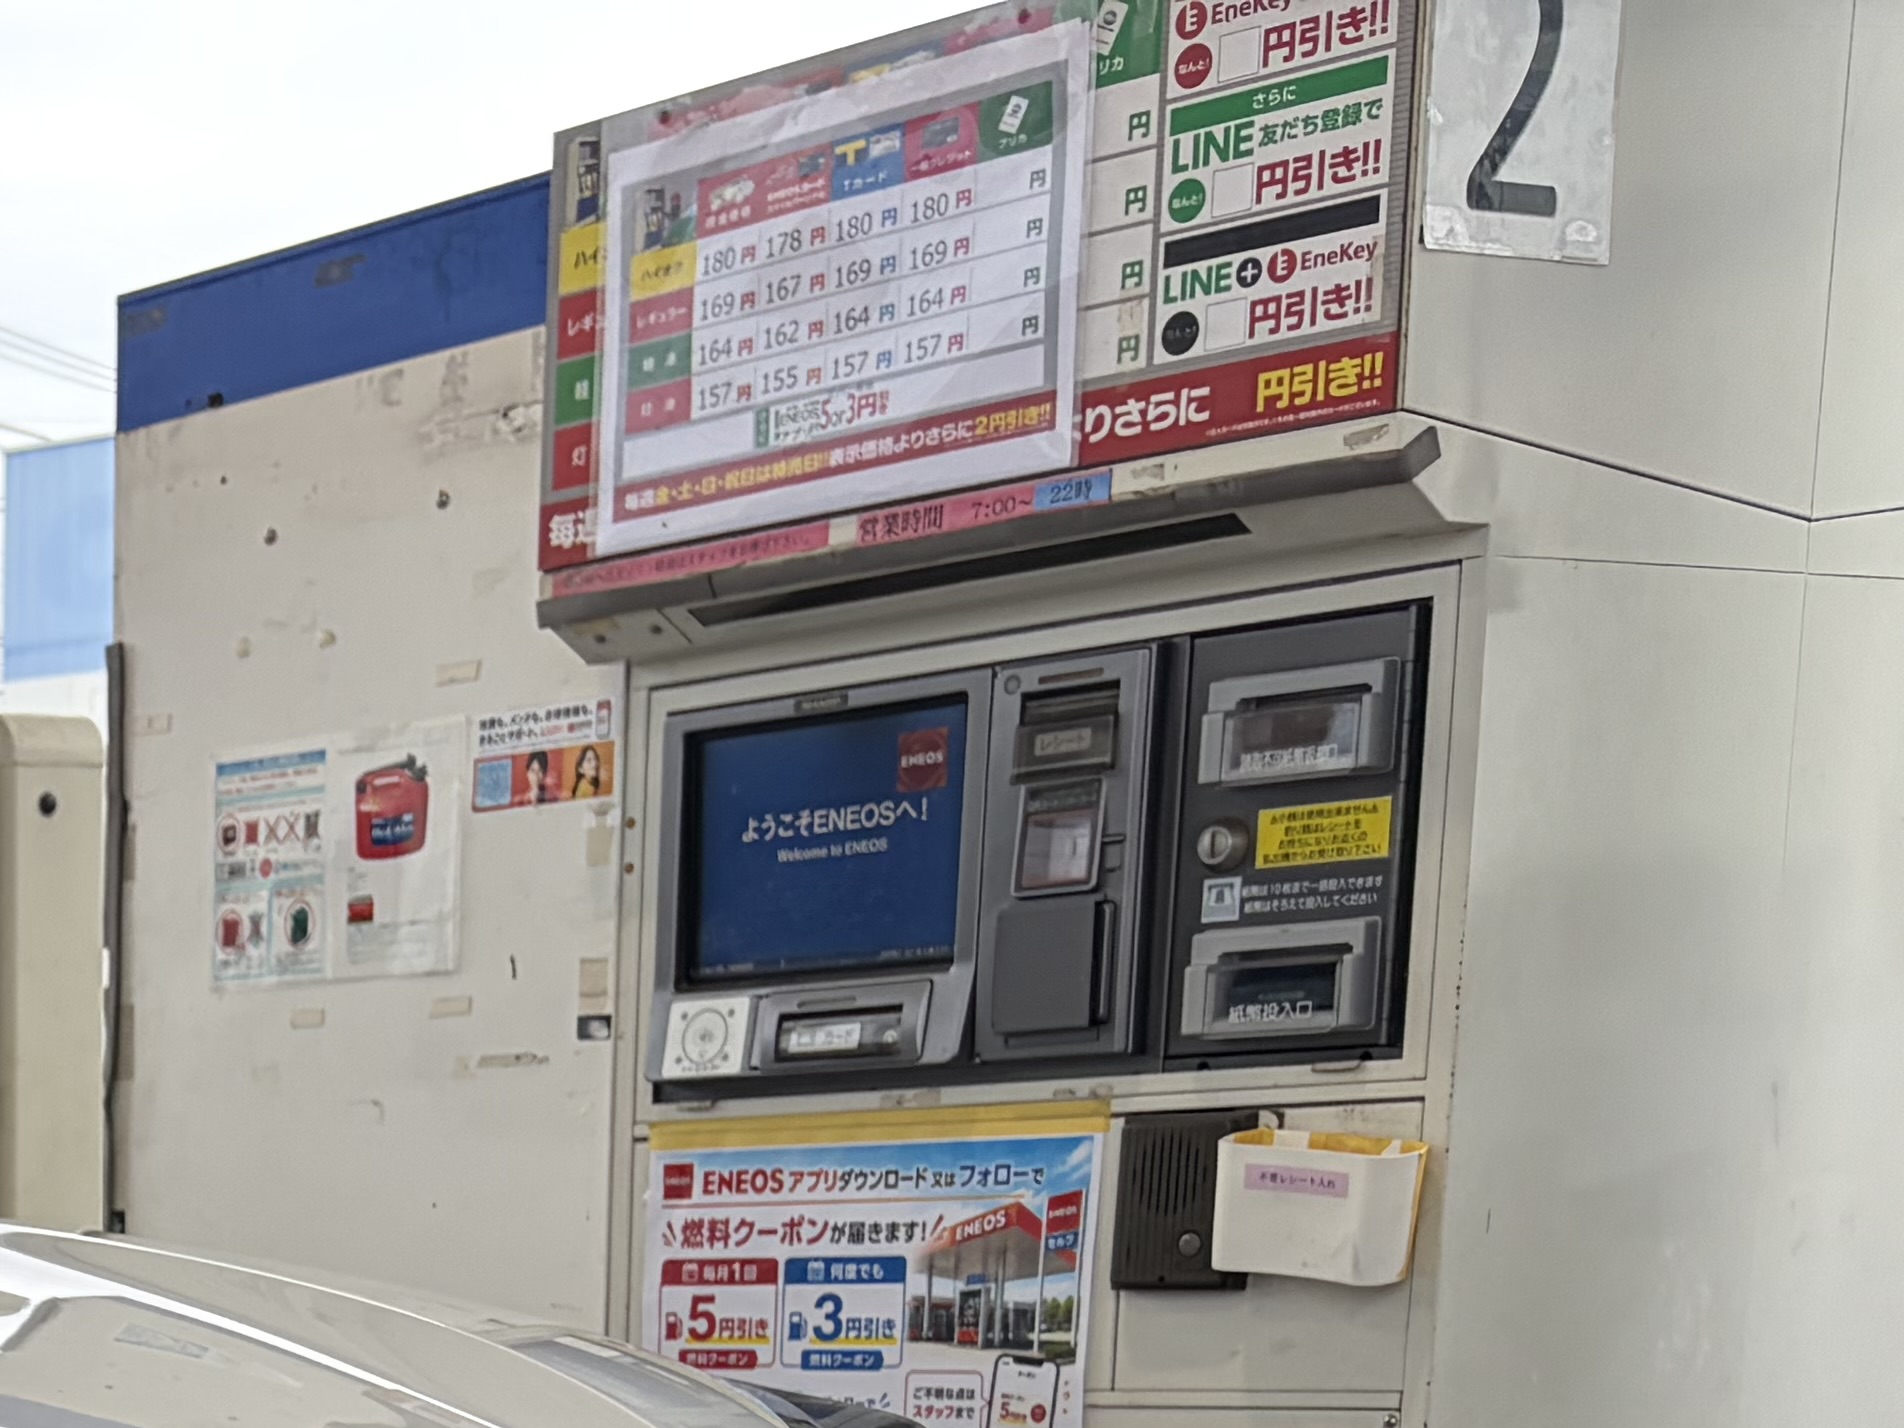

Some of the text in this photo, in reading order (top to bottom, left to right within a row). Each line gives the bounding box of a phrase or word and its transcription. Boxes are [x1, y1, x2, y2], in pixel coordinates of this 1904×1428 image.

[1262, 2, 1389, 68] 円引き!!
[1252, 86, 1296, 109] さらに
[1466, 0, 1563, 218] 2
[1128, 110, 1151, 141] 円
[1171, 98, 1382, 174] LINE 友だち登録で
[1255, 138, 1381, 206] 円引き!!
[1125, 185, 1147, 216] 円
[1122, 260, 1143, 289] 円
[1163, 240, 1379, 305] LINE EneKey
[1248, 276, 1373, 339] 円引き!!
[1117, 334, 1140, 364] 円
[1076, 386, 1210, 443] りさらに
[1257, 351, 1384, 412] 円引き!!
[860, 506, 944, 543] 営業時間
[1049, 479, 1093, 504] 22時
[900, 750, 944, 768] ENEOS
[777, 845, 828, 863] Welcome
[845, 837, 889, 855] ENEOS
[1228, 1001, 1312, 1023] 紙幣投入口
[702, 1168, 784, 1196] ENEOS
[959, 1163, 1045, 1189] フォローで
[680, 1214, 929, 1250] 燃料クーポンが届きます!
[955, 1209, 1007, 1242] ENEOS
[703, 1262, 758, 1282] 毎月1回
[830, 1263, 884, 1281] 何度でも
[912, 1386, 976, 1401] ご不明な点は
[912, 1405, 975, 1420] スタッフまで
